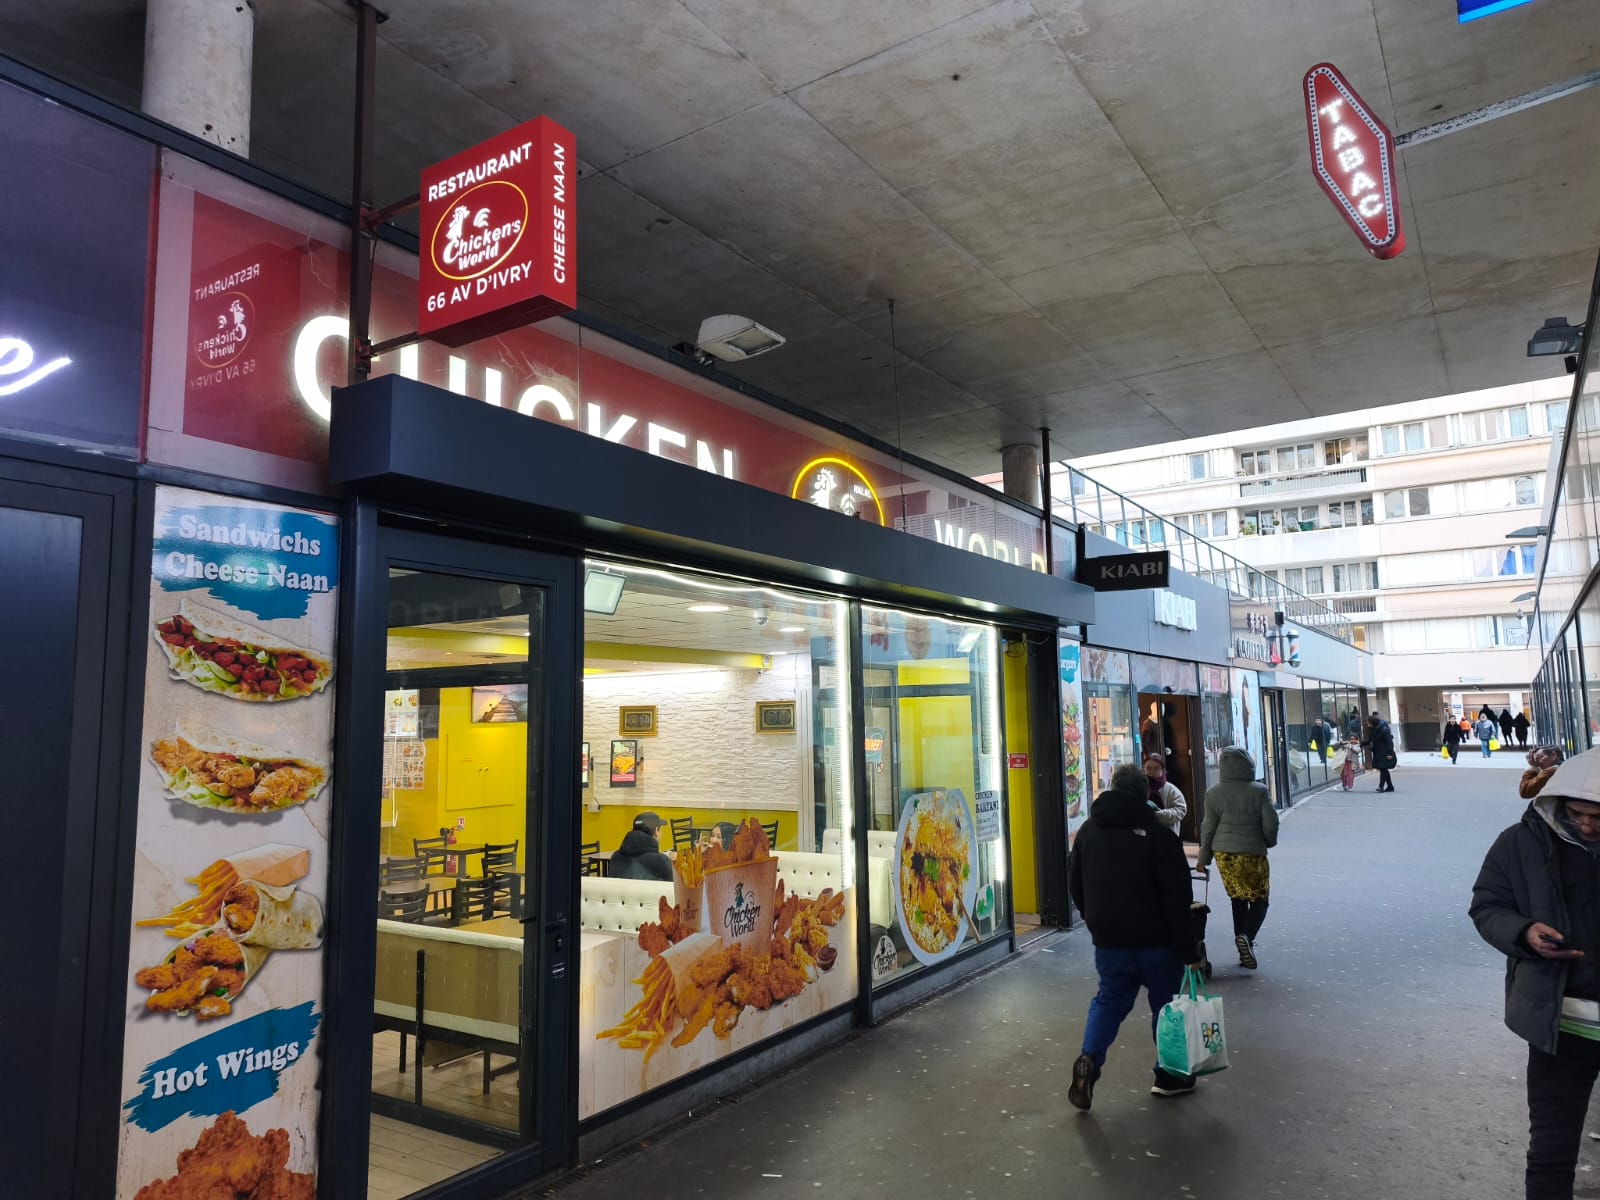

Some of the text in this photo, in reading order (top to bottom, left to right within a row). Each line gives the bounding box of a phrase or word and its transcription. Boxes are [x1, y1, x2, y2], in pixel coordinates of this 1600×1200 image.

[428, 141, 533, 202] RESTAURANT
[1319, 98, 1384, 219] TABAC
[553, 142, 566, 284] CHEESE NAAN
[458, 241, 500, 271] World
[427, 260, 532, 312] 66 AV D'IVRY
[179, 514, 321, 556] Sandwichs
[165, 551, 329, 593] Cheese Naan
[1101, 561, 1164, 579] KIABI
[1153, 588, 1197, 631] KIABI
[724, 903, 760, 928] Chicken
[731, 920, 755, 938] World
[152, 1041, 300, 1099] Hot Wings
